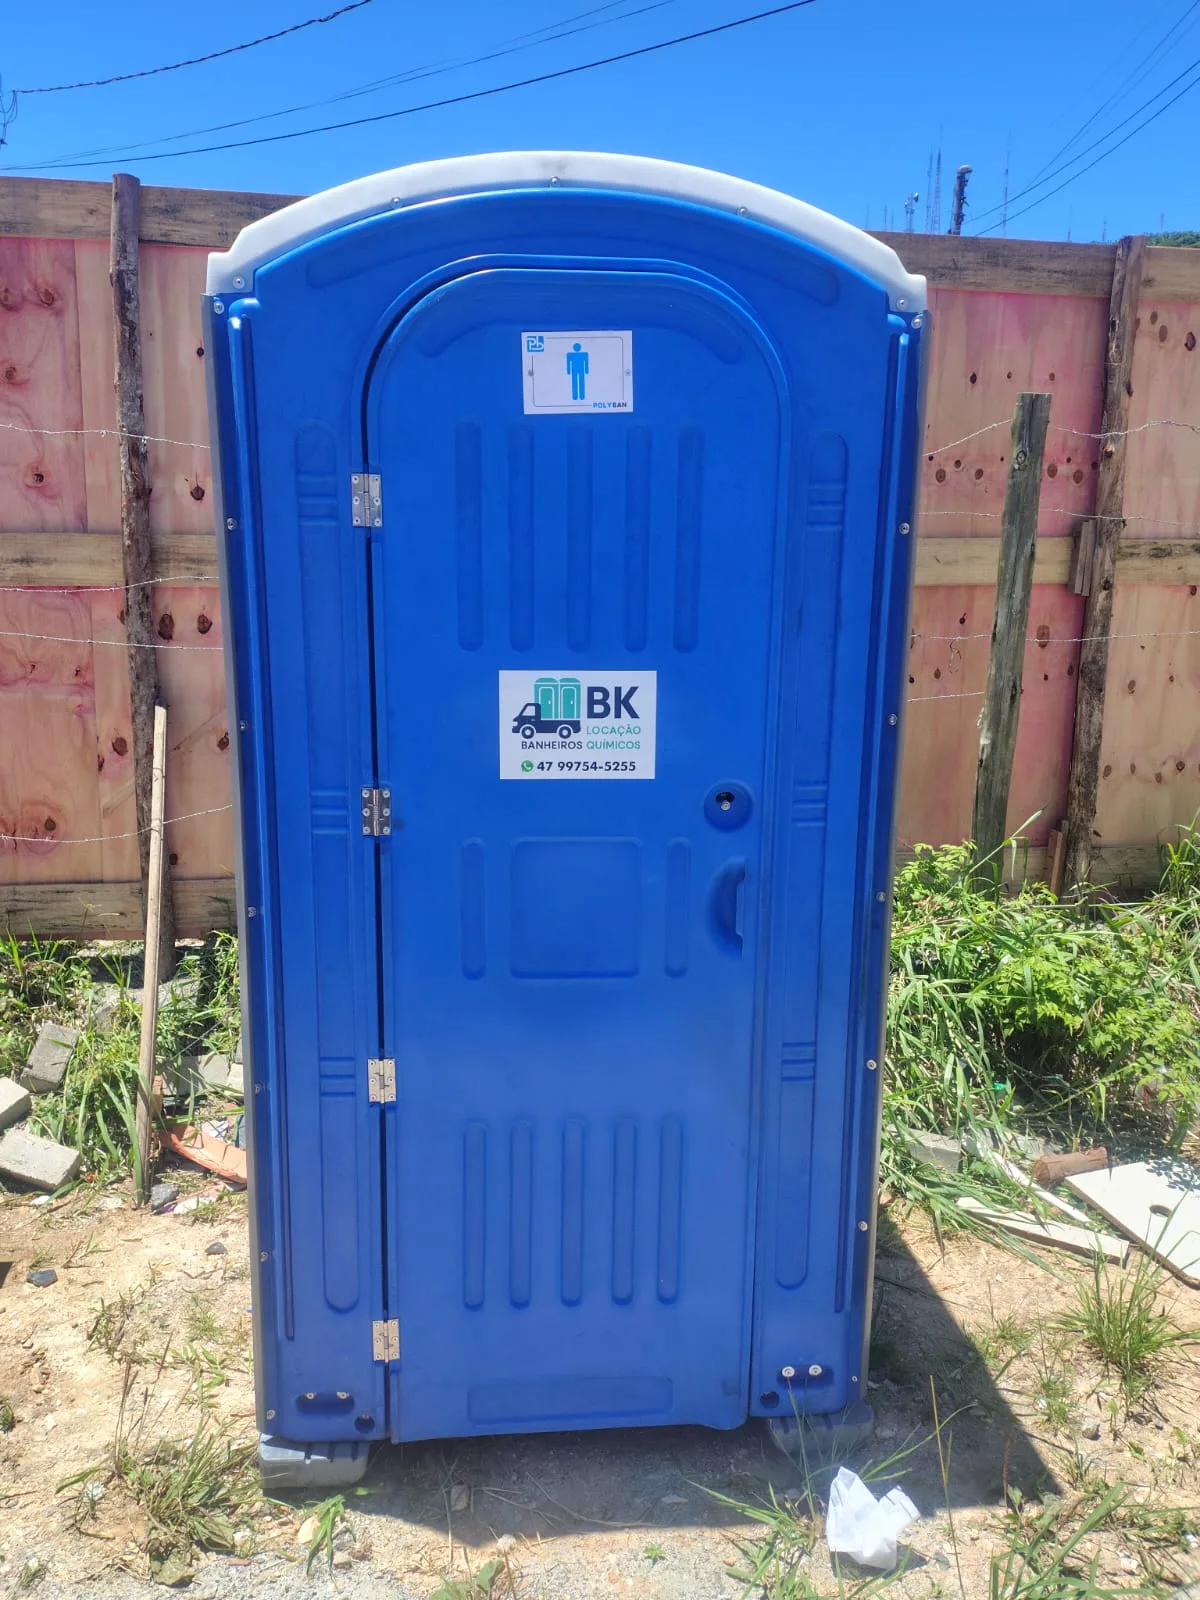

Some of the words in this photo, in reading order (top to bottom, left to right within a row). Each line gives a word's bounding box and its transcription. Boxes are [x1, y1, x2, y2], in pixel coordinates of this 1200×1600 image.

[586, 686, 640, 719] BK
[586, 724, 641, 736] LOCAÇÃO
[521, 740, 583, 750] BANHEIROS
[586, 739, 641, 750] QUÍMICOS
[537, 761, 553, 772] 47
[557, 761, 636, 772] 99754-5255
